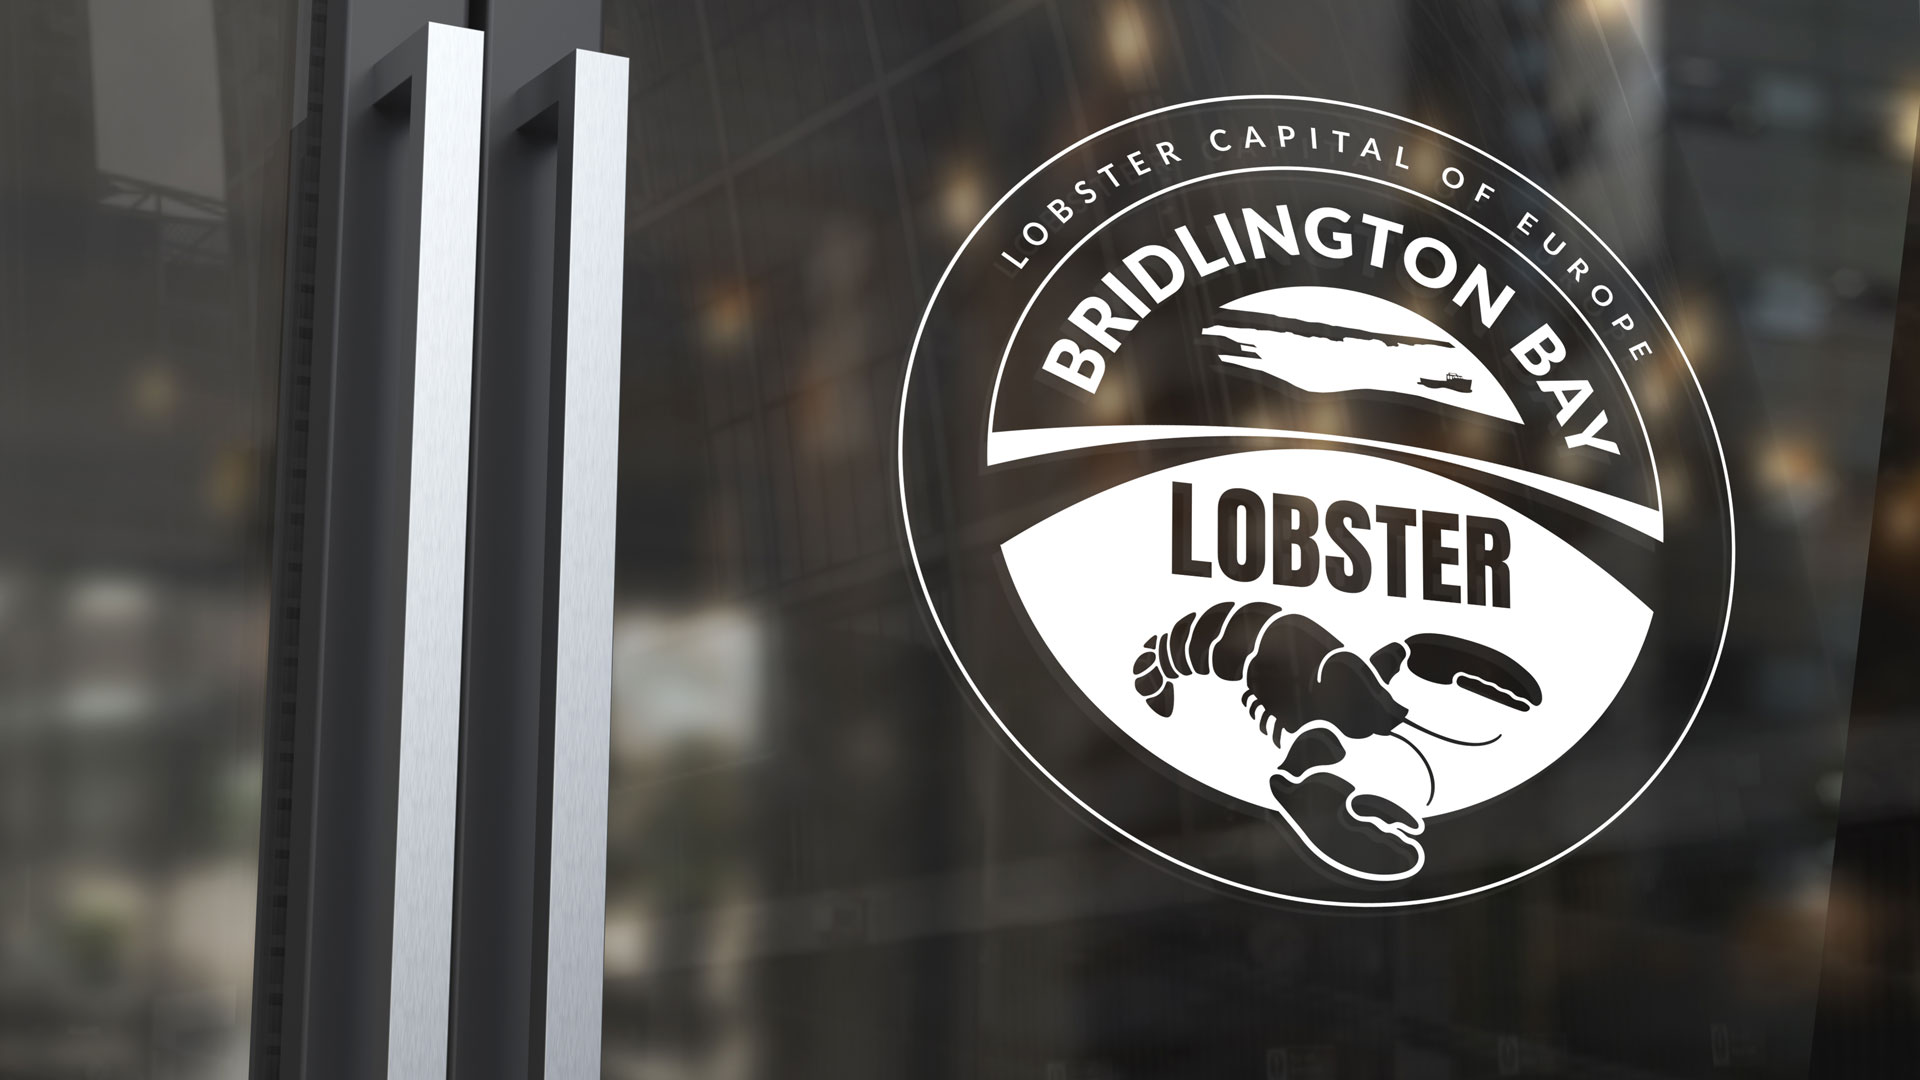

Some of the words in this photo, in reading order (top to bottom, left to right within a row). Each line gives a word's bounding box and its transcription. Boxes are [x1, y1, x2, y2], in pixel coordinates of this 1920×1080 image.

[1001, 141, 1183, 271] LOBSTER
[1209, 125, 1410, 170] CAPITAL
[1441, 166, 1496, 203] OF
[1516, 211, 1653, 361] EUROPE
[1041, 204, 1517, 395] BRIDLINGTON
[1510, 322, 1621, 456] BAY
[1171, 481, 1512, 609] LOBSTER
